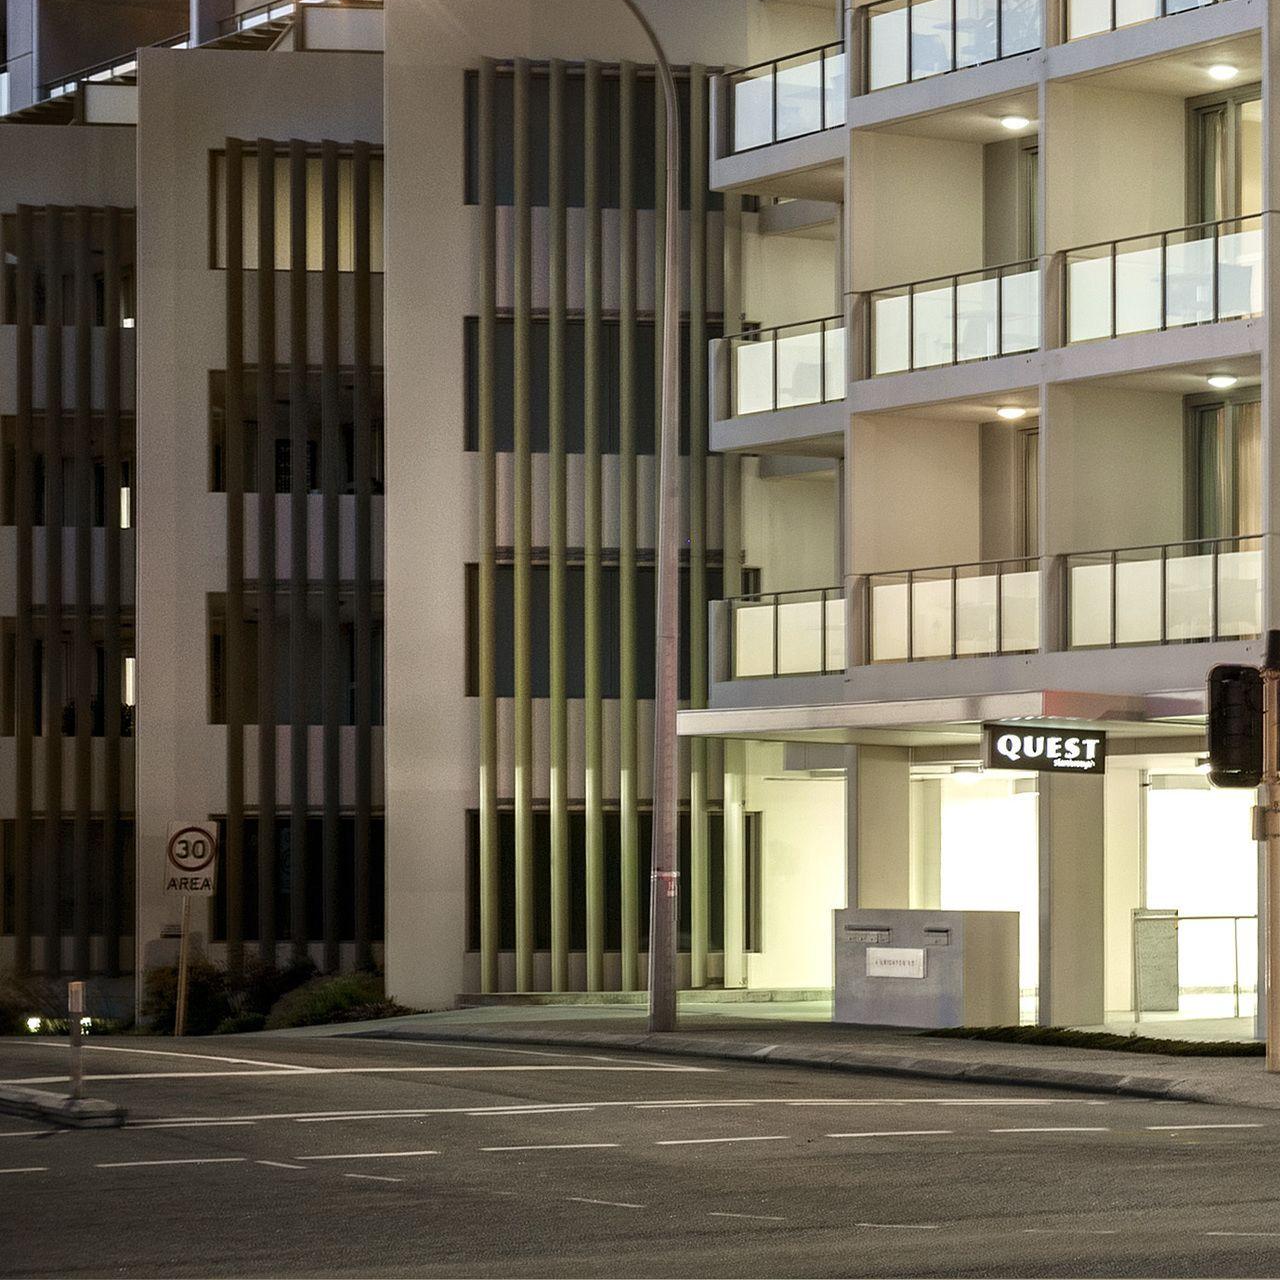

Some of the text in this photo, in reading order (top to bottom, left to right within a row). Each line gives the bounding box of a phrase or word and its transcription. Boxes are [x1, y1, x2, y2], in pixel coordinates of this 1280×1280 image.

[996, 733, 1100, 761] QUEST
[176, 839, 206, 859] 30
[167, 877, 212, 891] AREA
